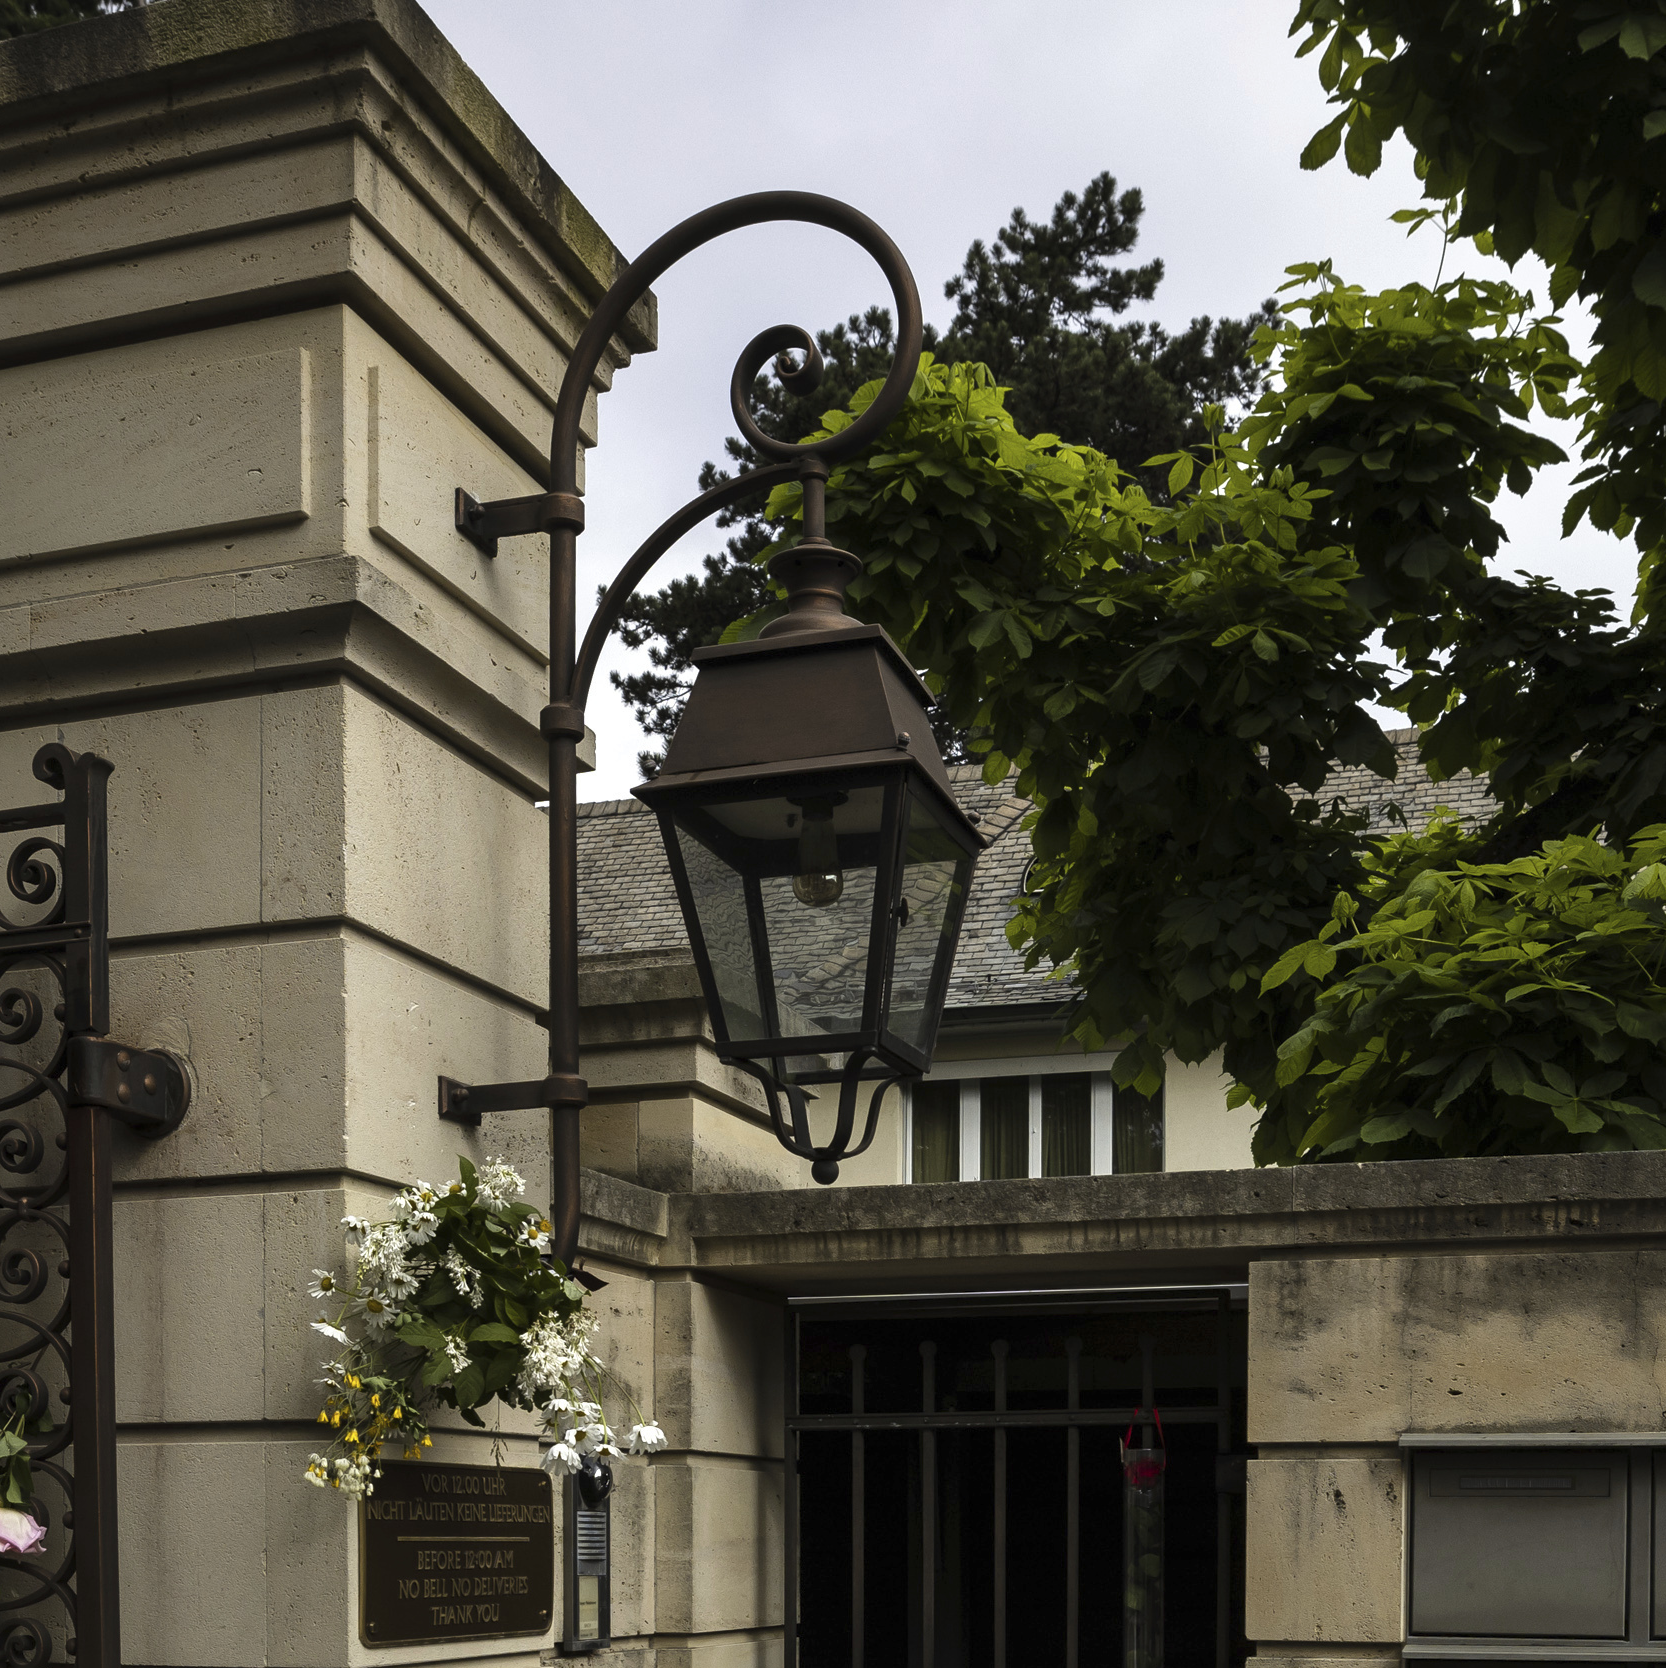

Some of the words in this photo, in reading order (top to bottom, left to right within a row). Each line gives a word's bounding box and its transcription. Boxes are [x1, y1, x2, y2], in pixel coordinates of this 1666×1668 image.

[421, 1473, 448, 1493] VOR
[452, 1475, 480, 1494] 12.00
[483, 1477, 507, 1496] UHR
[366, 1500, 406, 1520] NICHT
[409, 1498, 454, 1521] LÄUTEN
[457, 1503, 486, 1522] KEINE
[488, 1504, 551, 1523] LIEFERUNGEN
[417, 1550, 462, 1570] BEFORE
[465, 1550, 493, 1569] 12:00
[494, 1550, 514, 1569] AM
[398, 1579, 420, 1600] NO
[423, 1579, 448, 1598] BELL
[451, 1577, 471, 1597] NO
[474, 1576, 529, 1596] DELIVERIES
[430, 1605, 474, 1626] THANK
[476, 1603, 500, 1623] YOU
